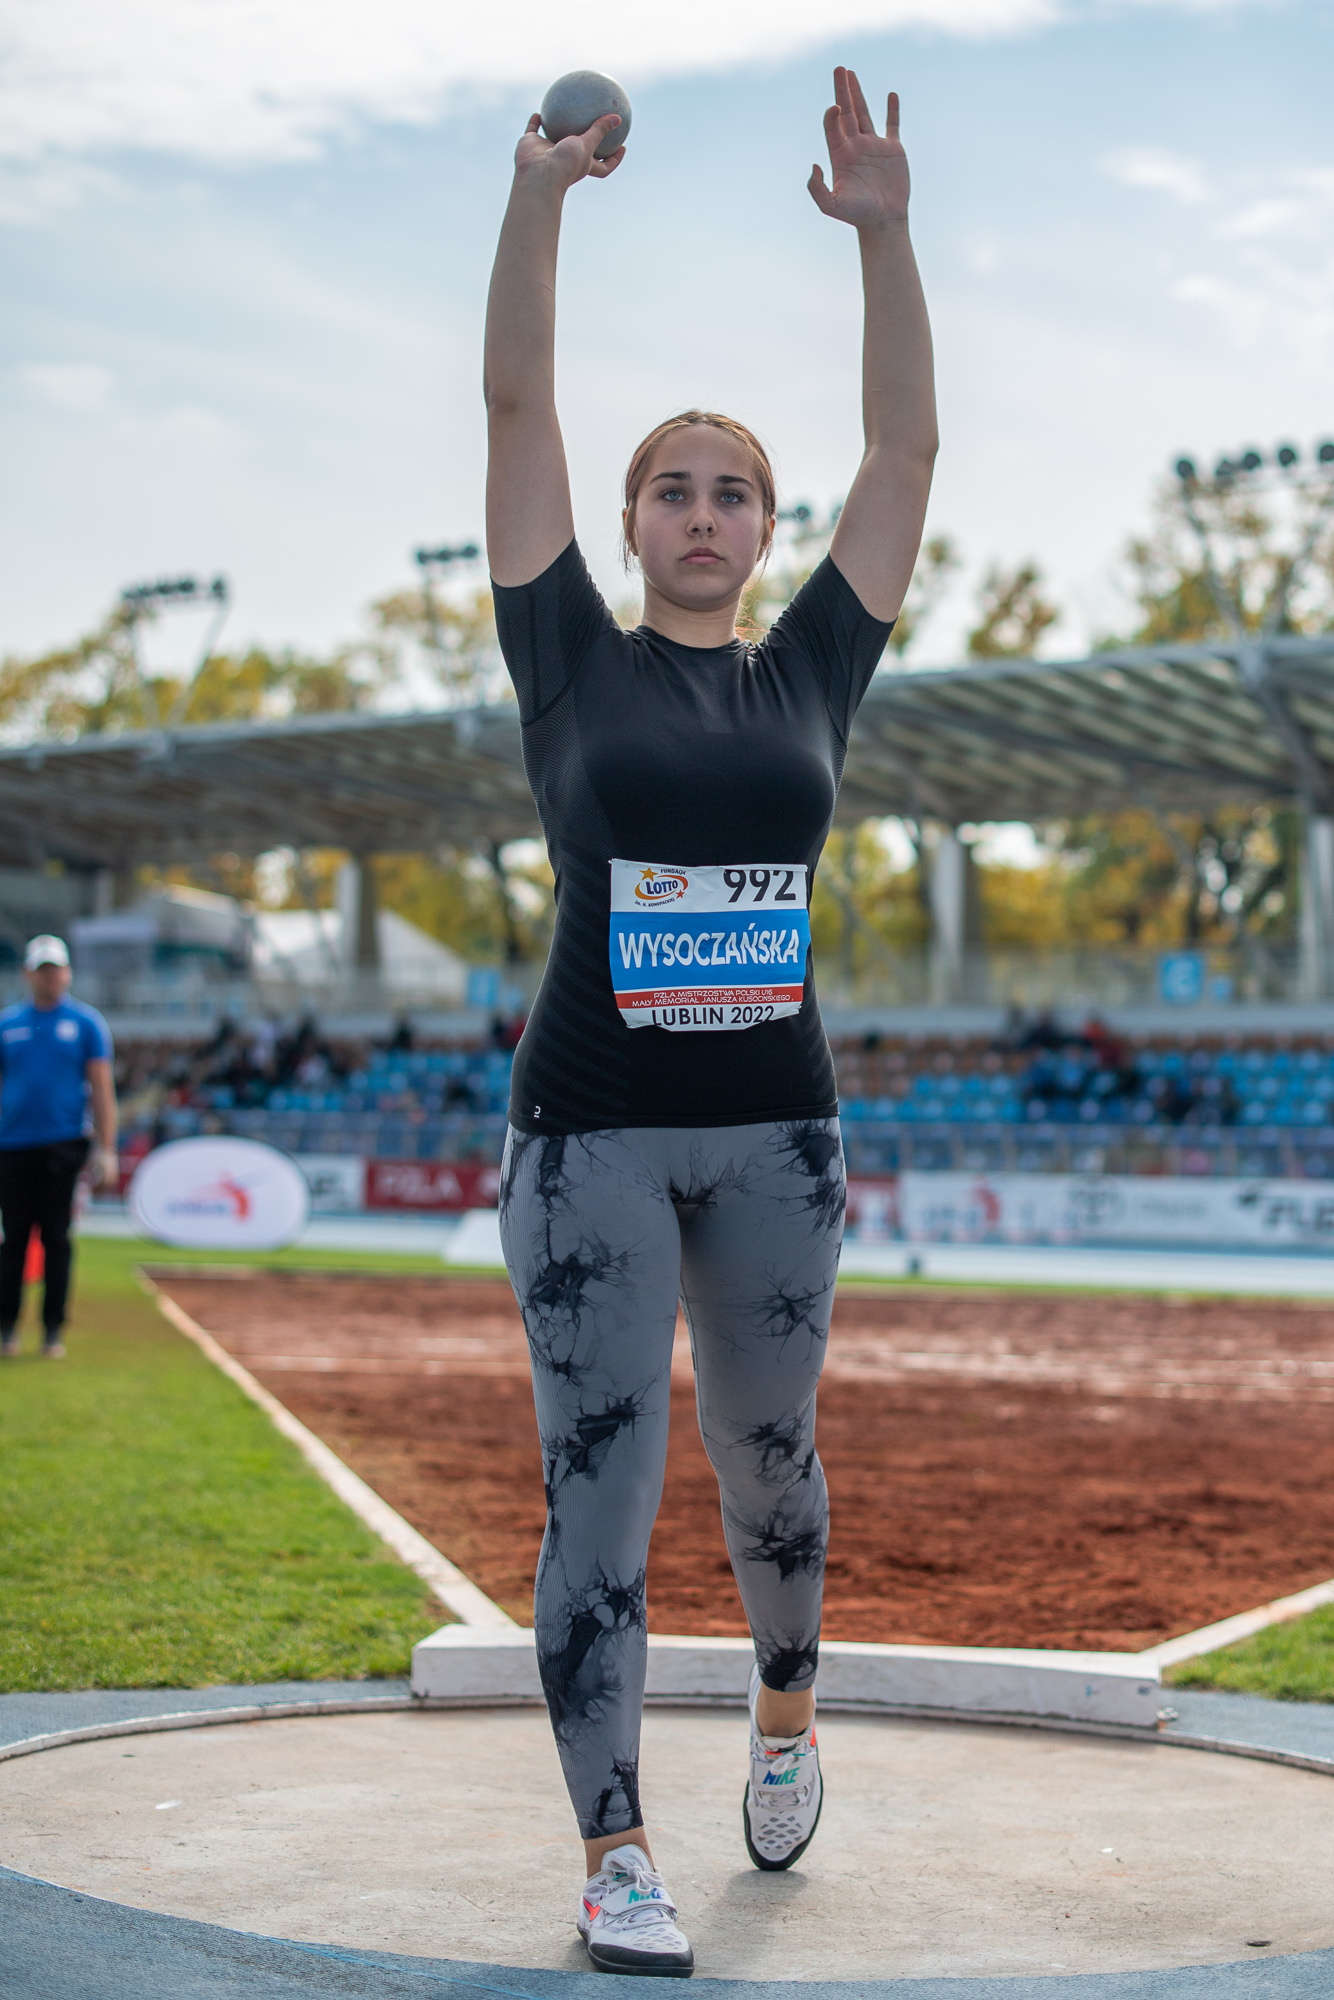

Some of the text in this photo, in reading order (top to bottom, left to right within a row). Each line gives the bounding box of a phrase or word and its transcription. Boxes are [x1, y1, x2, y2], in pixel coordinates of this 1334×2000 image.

[645, 880, 679, 895] LOTTO
[723, 869, 797, 903] 992
[618, 922, 800, 969] WYSOCZAŃSKA
[632, 999, 653, 1007] MAŁY
[654, 997, 700, 1005] MEMORIAŁ
[701, 996, 737, 1004] JANUSZA
[653, 991, 676, 999] PZLA
[677, 989, 735, 998] MISTRZOSTWA
[761, 988, 773, 996] U16
[652, 1005, 774, 1026] LUBLIN 2022
[762, 1767, 800, 1785] NIKE
